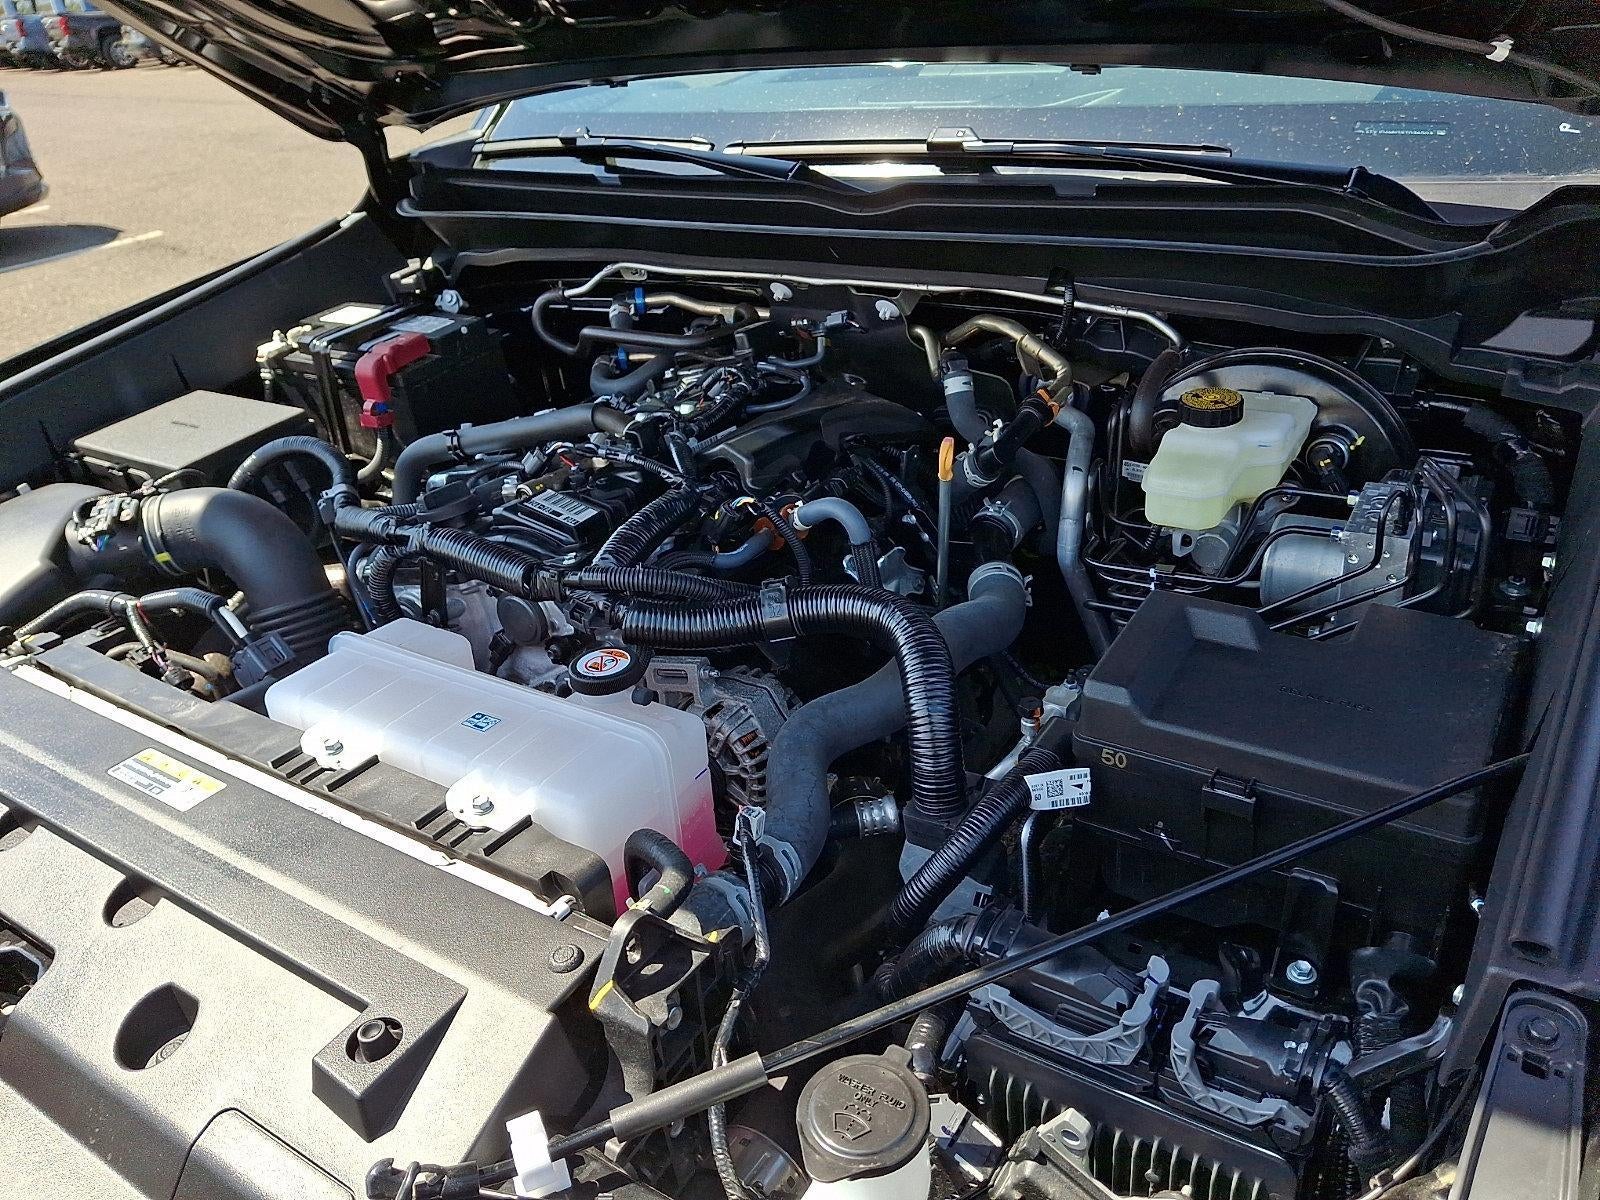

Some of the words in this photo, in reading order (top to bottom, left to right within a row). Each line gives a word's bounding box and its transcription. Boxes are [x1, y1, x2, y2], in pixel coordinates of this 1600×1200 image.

[1101, 748, 1127, 769] 50
[838, 1073, 876, 1097] WASHER
[878, 1092, 907, 1110] FLUID
[853, 1091, 879, 1108] ONLY
